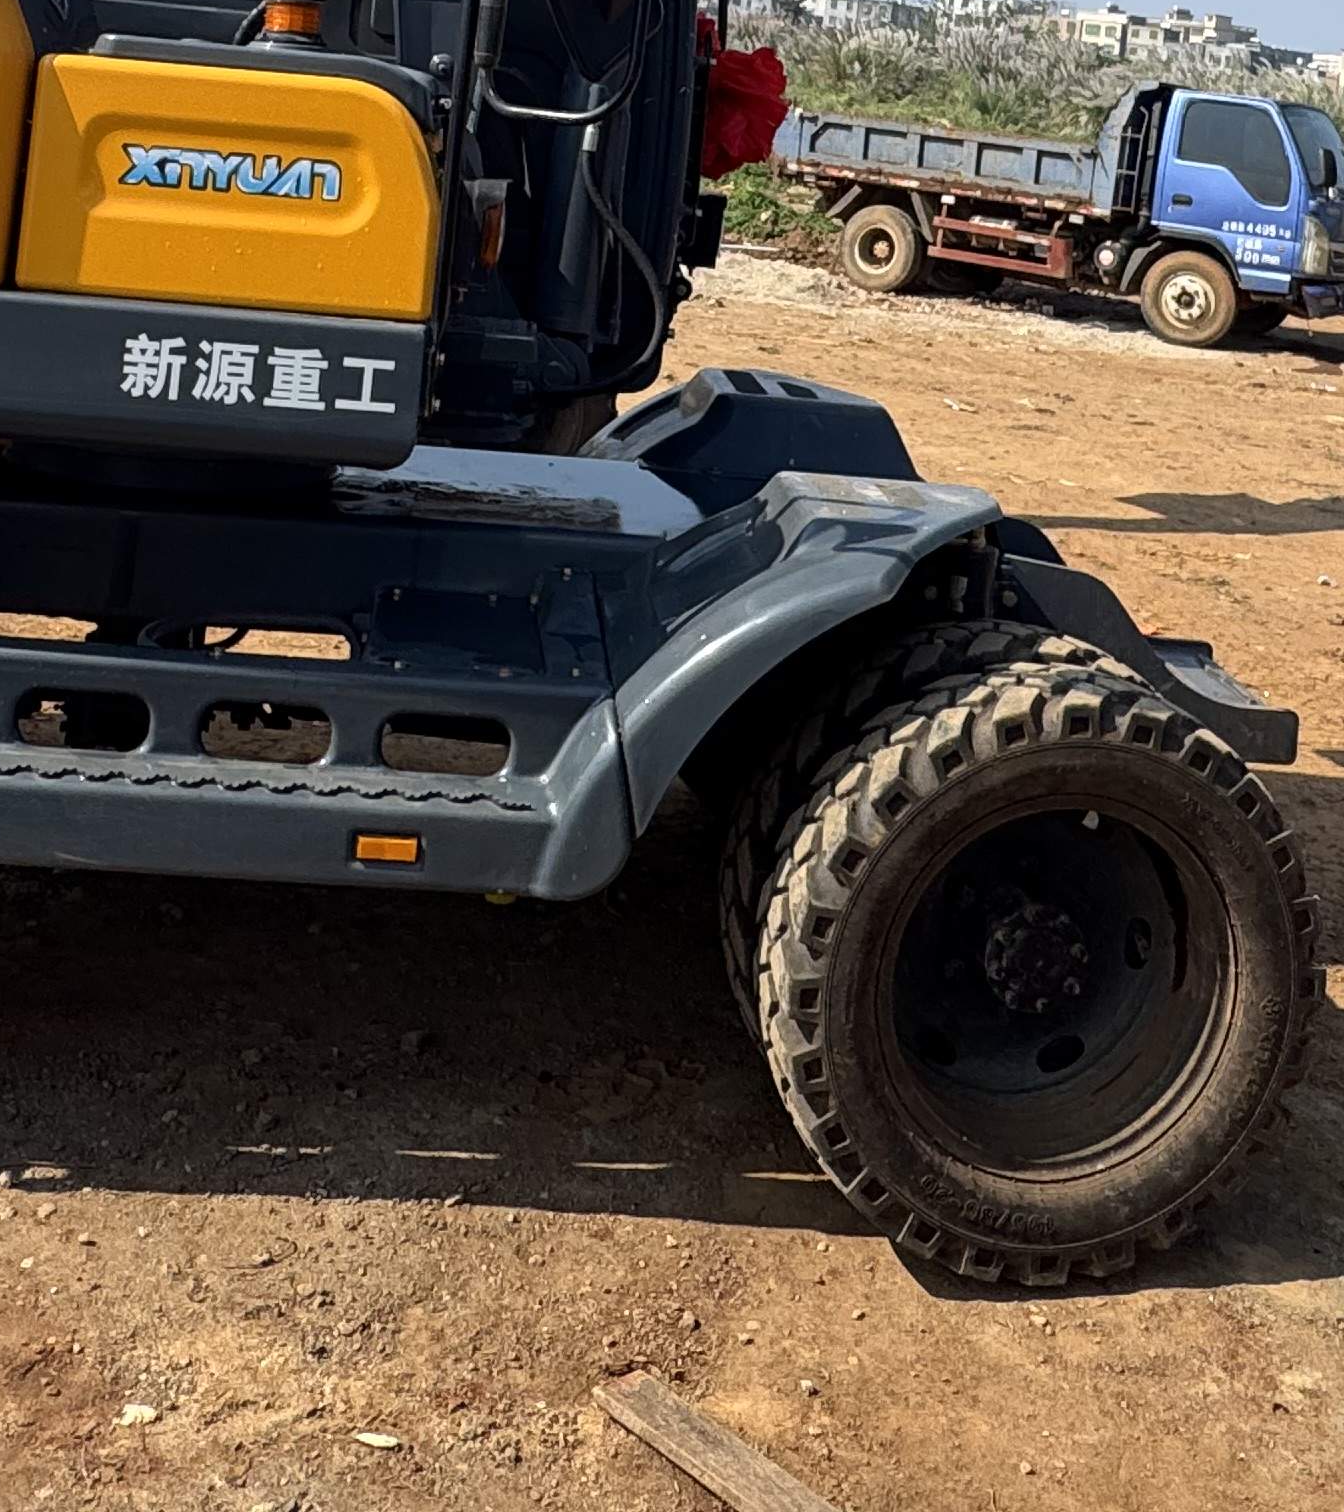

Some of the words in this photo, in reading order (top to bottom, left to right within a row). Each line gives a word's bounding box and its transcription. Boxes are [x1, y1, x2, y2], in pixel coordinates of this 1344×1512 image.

[120, 143, 343, 201] XINYUAN
[120, 333, 396, 414] 新源重工
